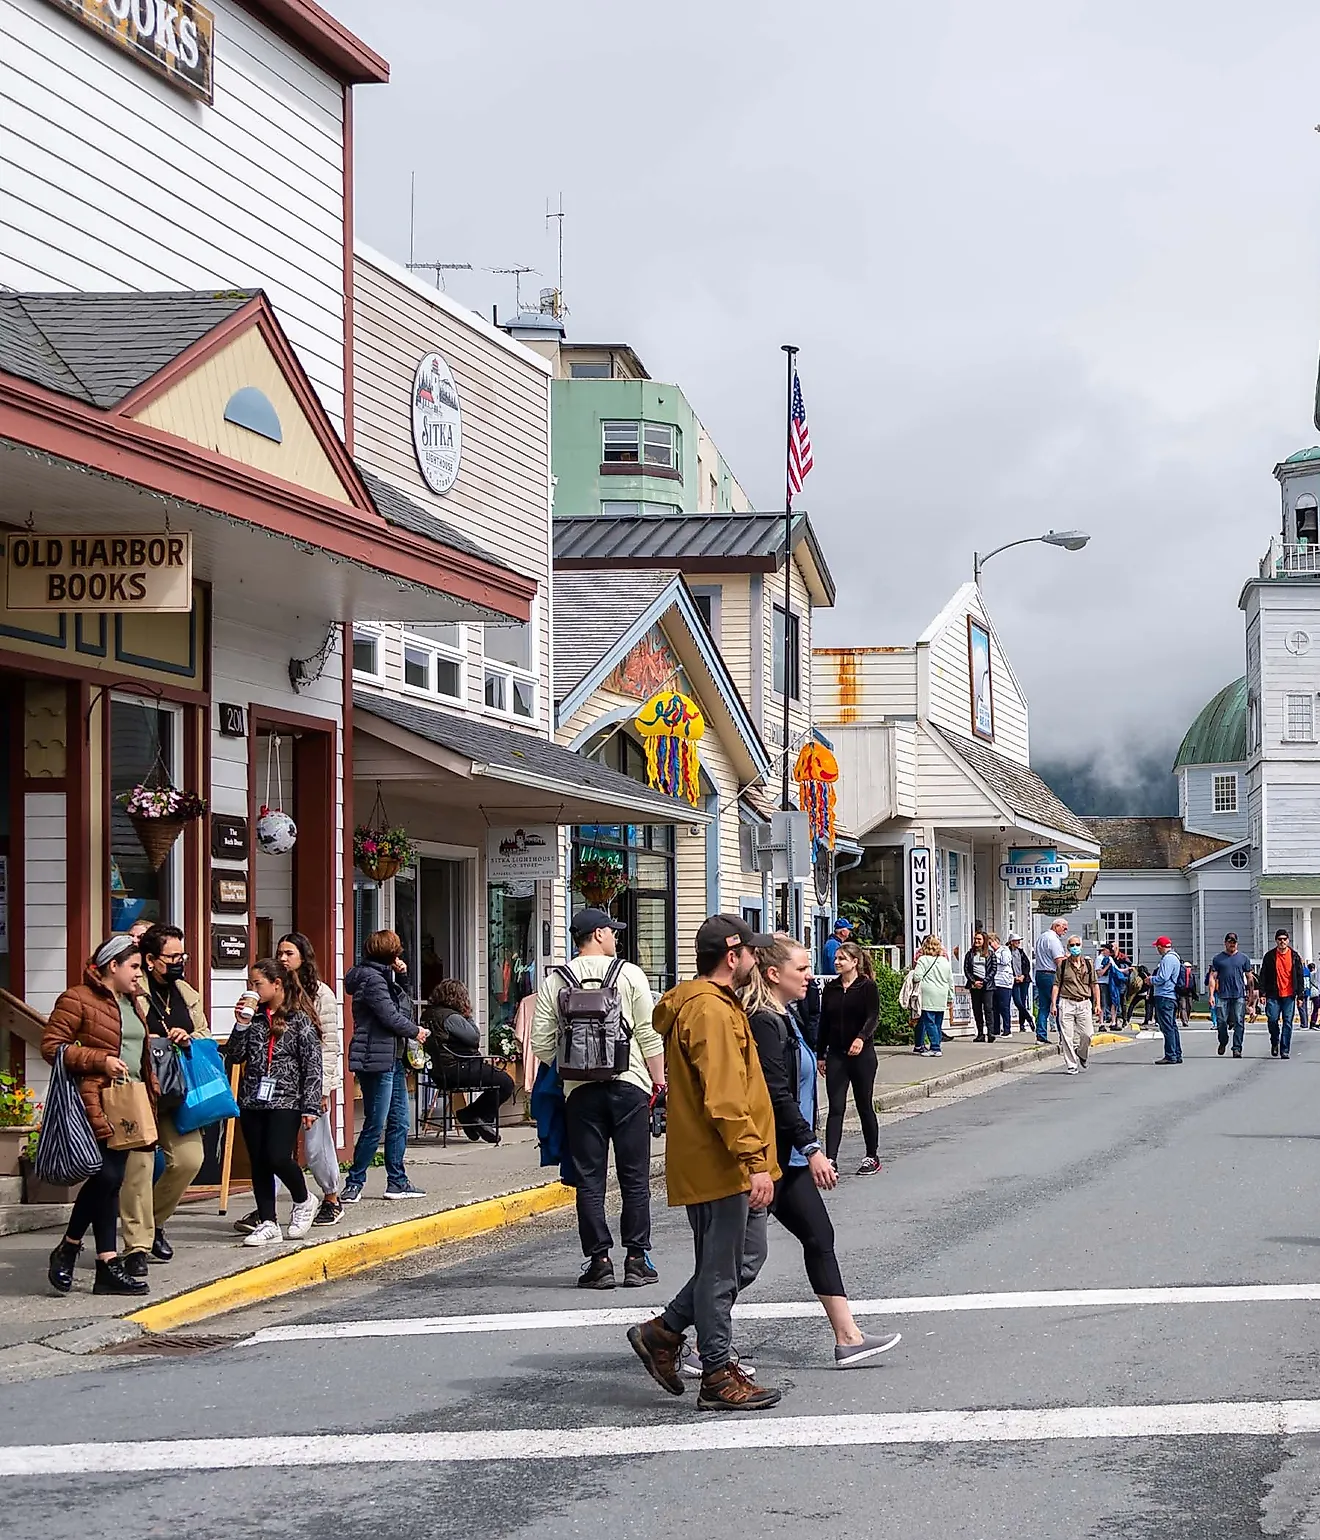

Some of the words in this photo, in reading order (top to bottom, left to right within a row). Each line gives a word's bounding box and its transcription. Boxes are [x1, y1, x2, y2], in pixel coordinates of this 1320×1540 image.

[422, 415, 454, 447] SITKA
[13, 539, 63, 567] OLD
[71, 538, 184, 566] HARBOR
[49, 572, 147, 601] BOOKS
[227, 707, 243, 732] 201
[1005, 866, 1032, 874] Blue
[1034, 865, 1063, 875] Eyed
[1016, 876, 1053, 886] BEAR
[913, 856, 927, 949] MUSEUM
